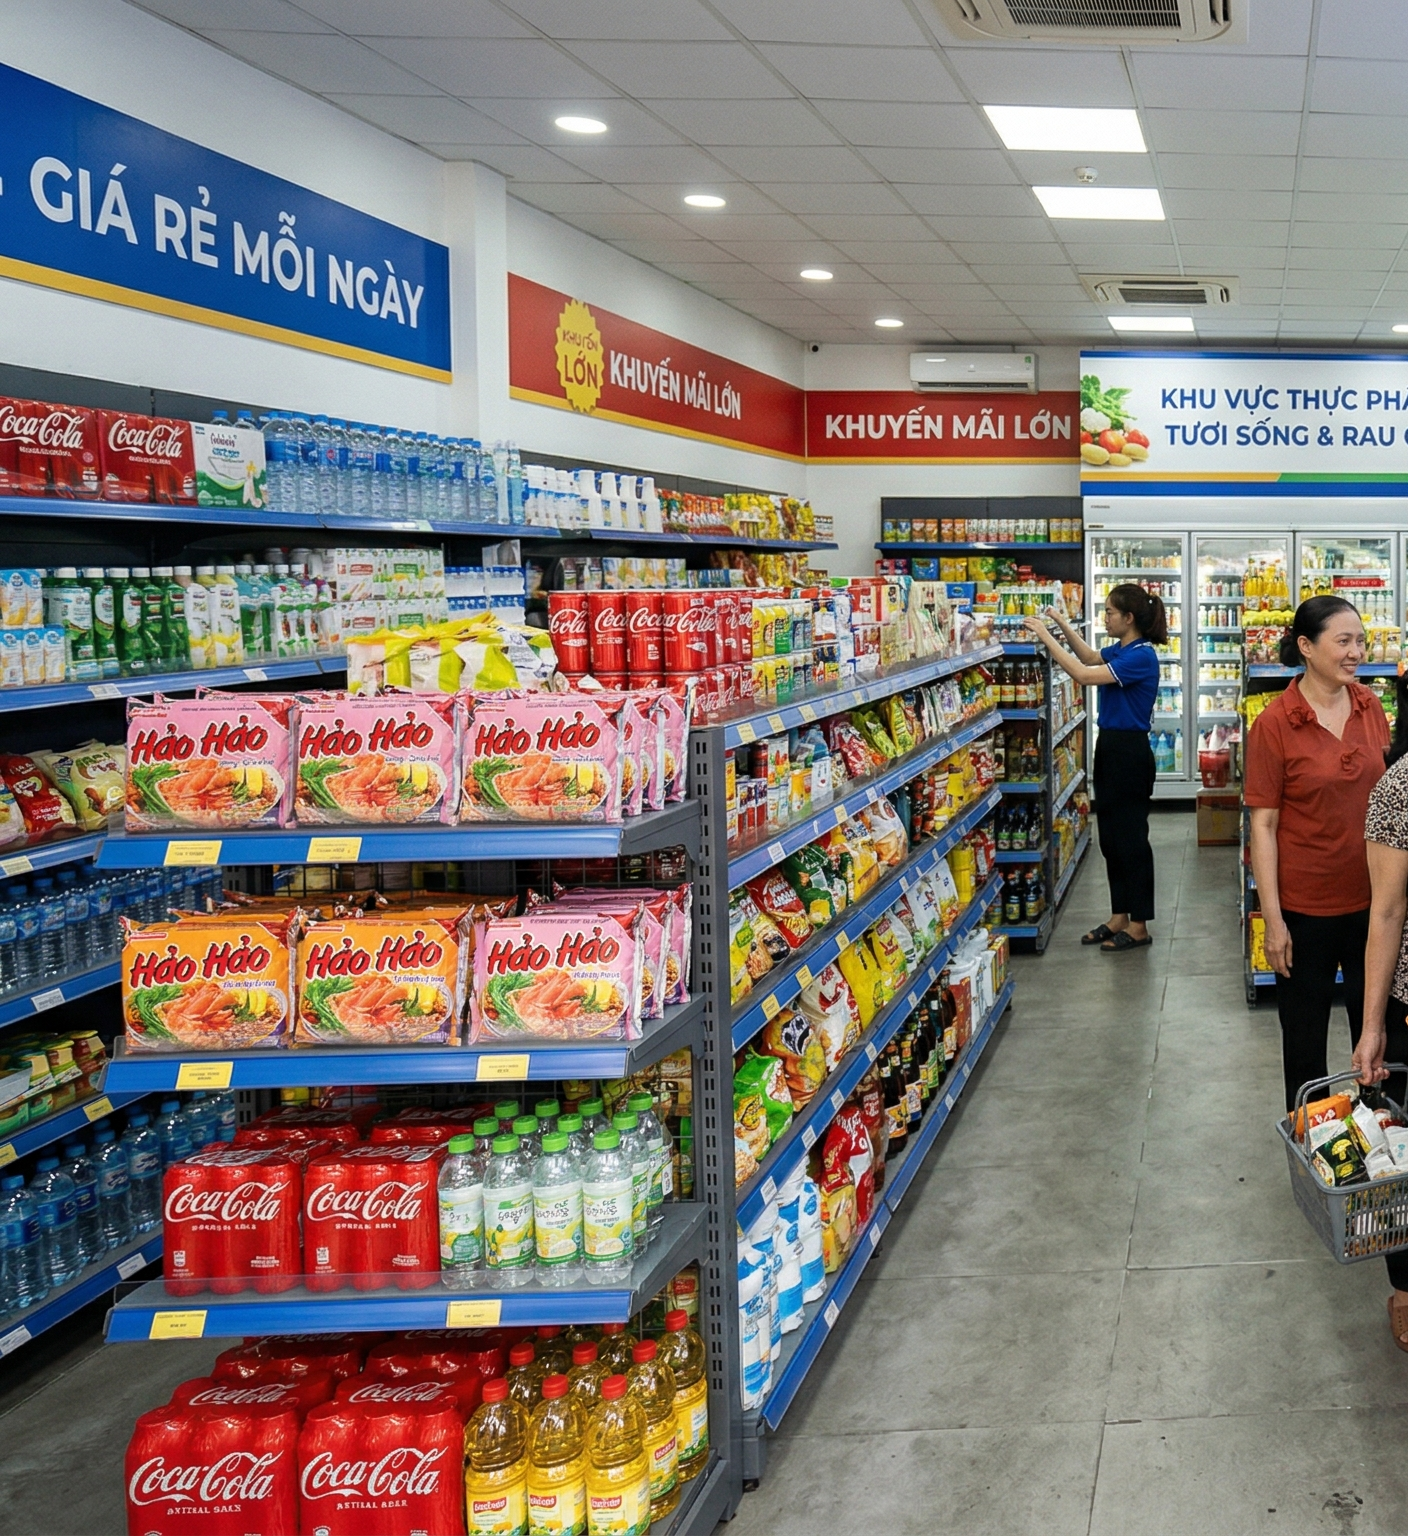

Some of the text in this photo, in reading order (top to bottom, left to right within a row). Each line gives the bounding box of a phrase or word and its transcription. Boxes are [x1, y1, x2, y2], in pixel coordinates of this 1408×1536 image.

[30, 156, 424, 329] GIÁ RẺ MỖI NGÀY
[564, 350, 598, 390] LỚN
[684, 370, 711, 412] MÃI
[714, 381, 741, 420] LỚN
[1161, 388, 1216, 410] KHU
[1224, 384, 1280, 416] VỰC
[1286, 385, 1358, 416] THỰC
[825, 405, 1071, 440] KHUYẾN MÃI LỚN
[1165, 420, 1228, 446] TƯƠI
[1236, 417, 1309, 447] SỐNG
[1317, 425, 1334, 447] &
[1342, 426, 1396, 447] RAU
[130, 715, 269, 766] Hảo Hảo
[300, 710, 434, 760] Hảo Hảo
[474, 710, 601, 758] Hảo Hảo
[129, 935, 271, 989] Hảo Hảo
[305, 930, 443, 980] Hảo Hảo
[487, 926, 621, 975] Hảo Hảo
[164, 1180, 291, 1223] Coca-Cola
[306, 1180, 430, 1223] Coca-Cola
[129, 1449, 285, 1507] Coca-Cola
[301, 1446, 450, 1501] Coca-Cola
